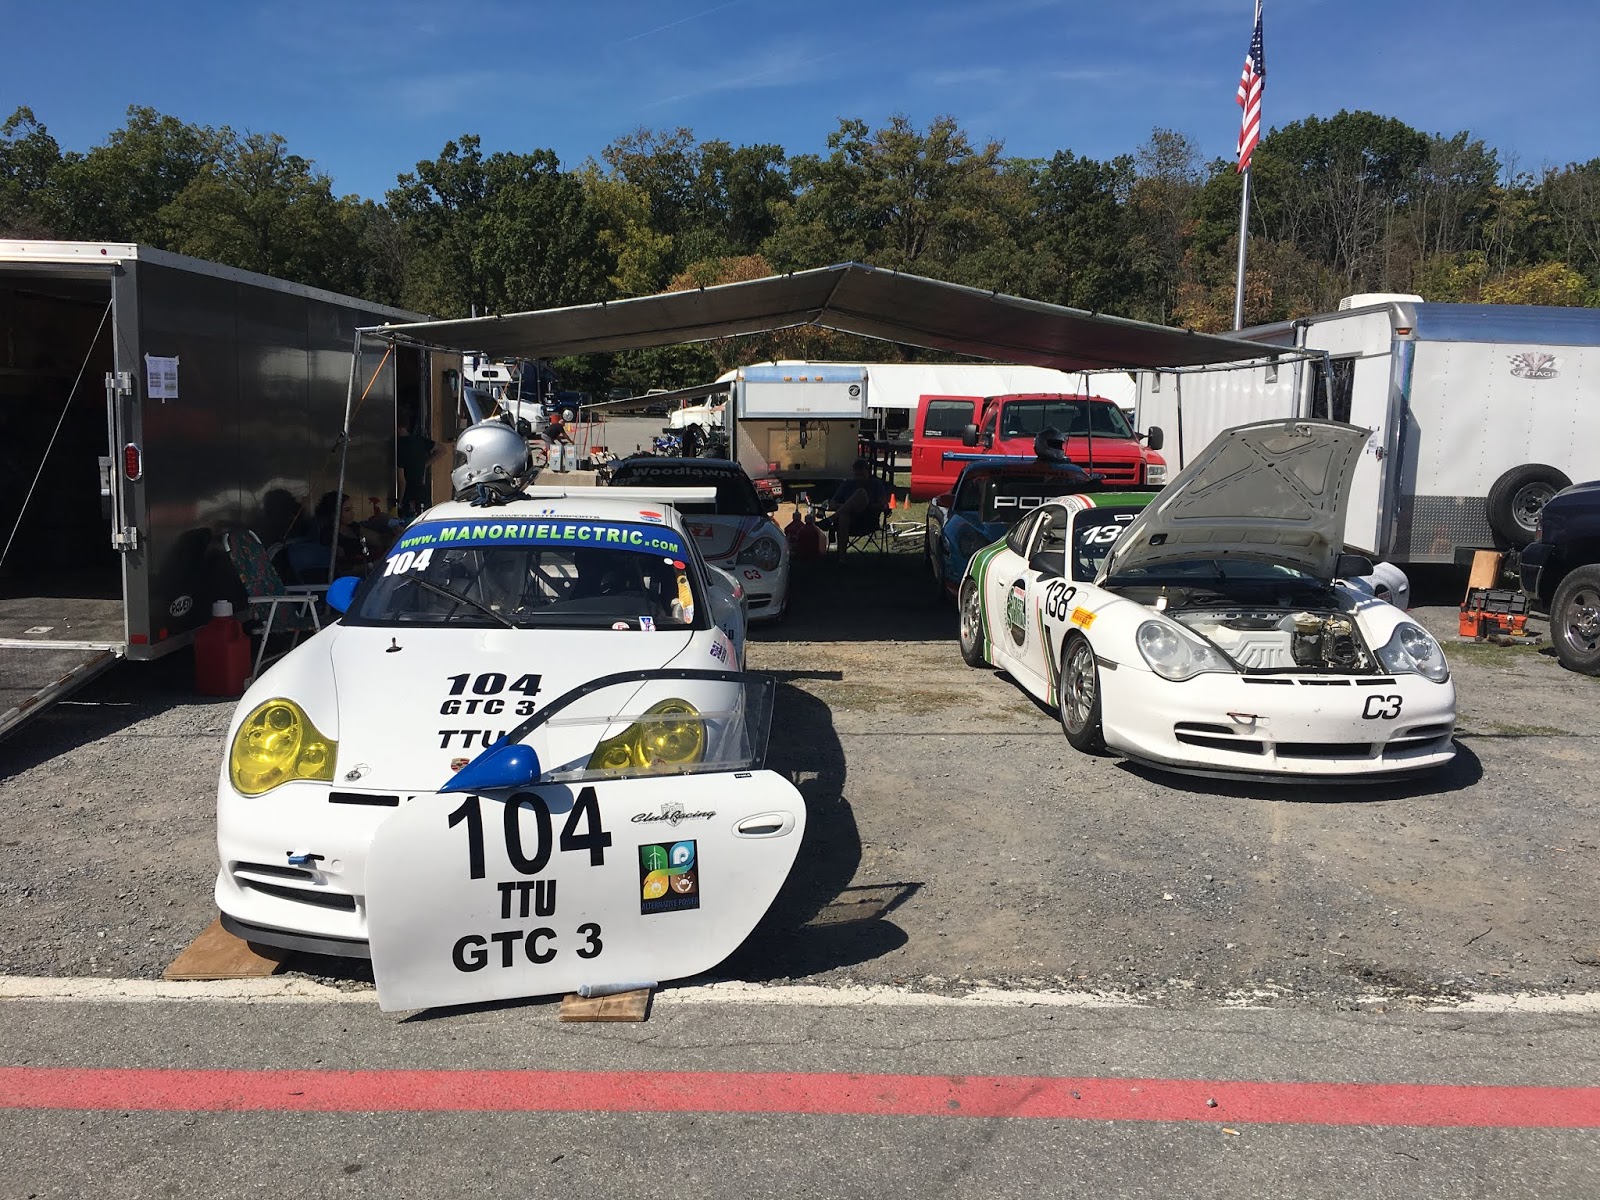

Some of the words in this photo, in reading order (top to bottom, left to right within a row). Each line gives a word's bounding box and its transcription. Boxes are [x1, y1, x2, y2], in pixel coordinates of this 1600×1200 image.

[993, 496, 1057, 510] PO
[1083, 525, 1128, 546] 13
[383, 548, 435, 577] 104
[743, 569, 761, 580] C3
[1045, 580, 1077, 622] 138
[446, 672, 543, 697] 104
[440, 699, 505, 716] GTC
[515, 700, 536, 716] 3
[1361, 694, 1403, 720] C3
[438, 729, 507, 749] TTU
[447, 786, 613, 880] 104
[497, 879, 557, 920] TTU
[678, 896, 699, 906] POWER
[451, 926, 558, 973] GTC
[575, 922, 604, 960] 3
